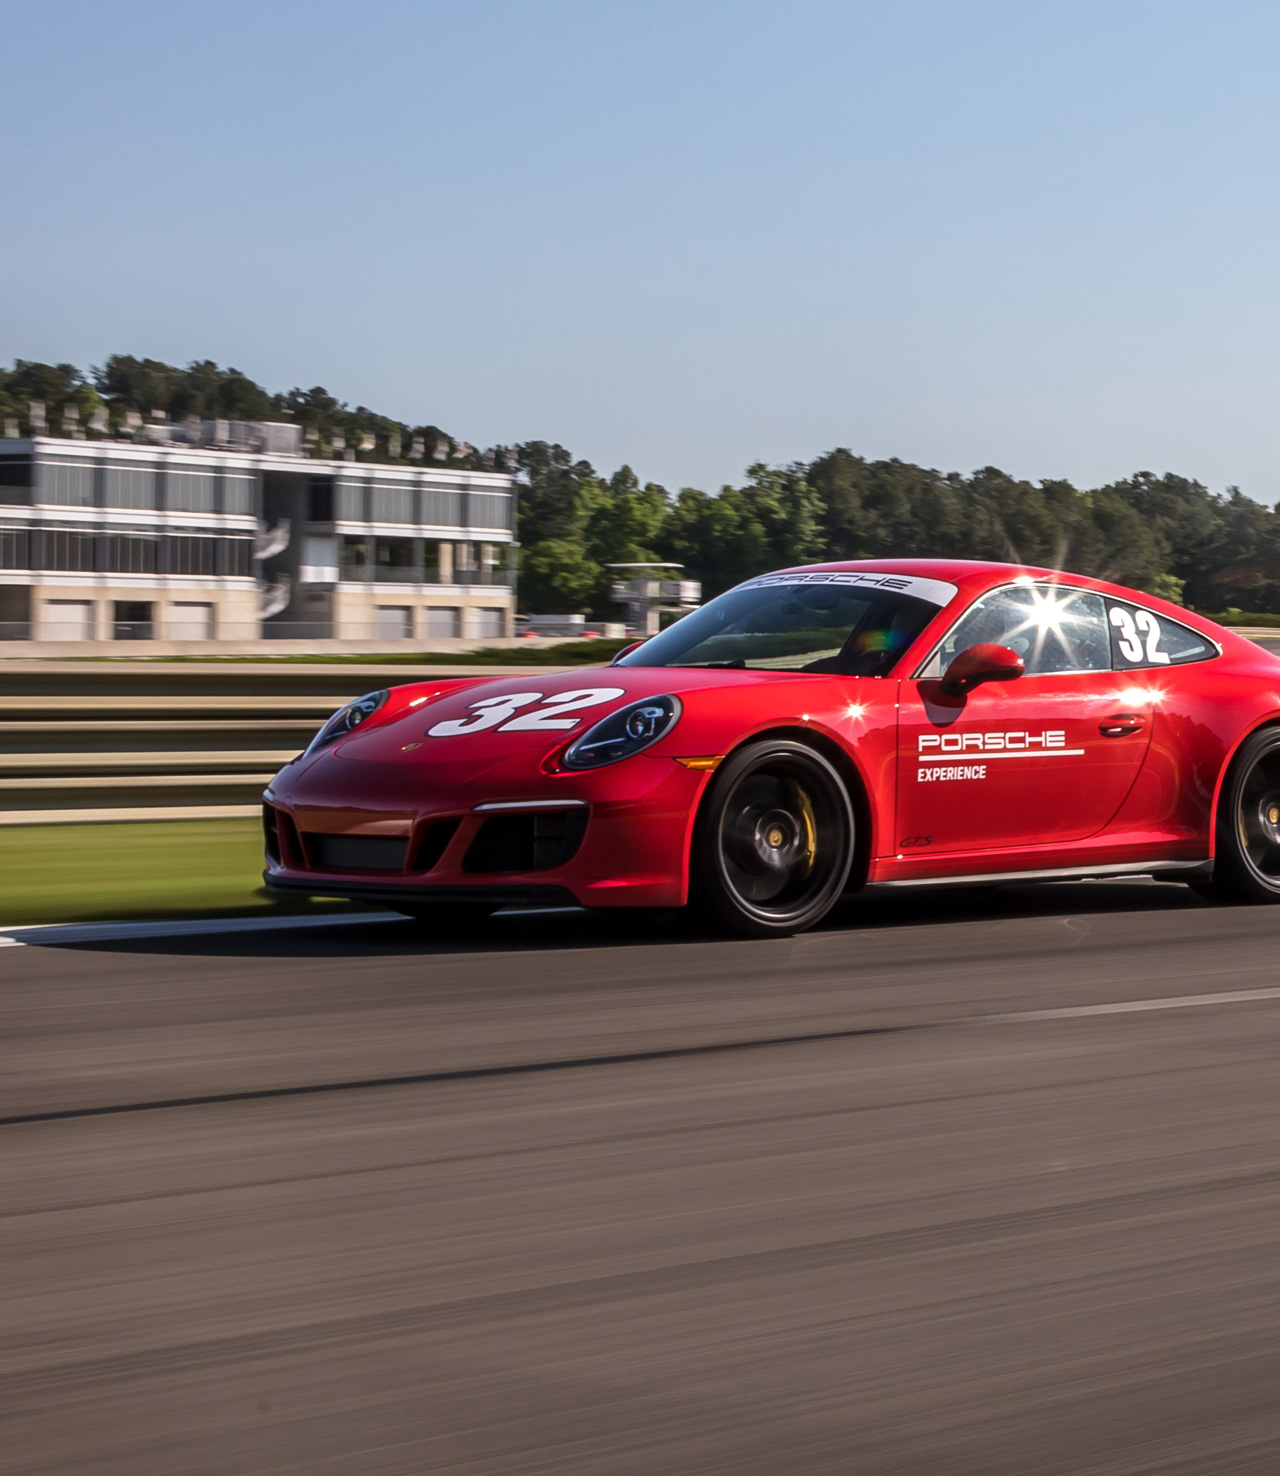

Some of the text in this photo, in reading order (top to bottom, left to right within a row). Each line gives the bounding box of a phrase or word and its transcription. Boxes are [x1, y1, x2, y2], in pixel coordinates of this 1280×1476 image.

[1109, 607, 1171, 664] 32
[425, 687, 627, 738] 32
[918, 730, 1066, 752] PORSCHE
[917, 765, 987, 782] EXPERIENCE
[899, 835, 934, 849] GTS
